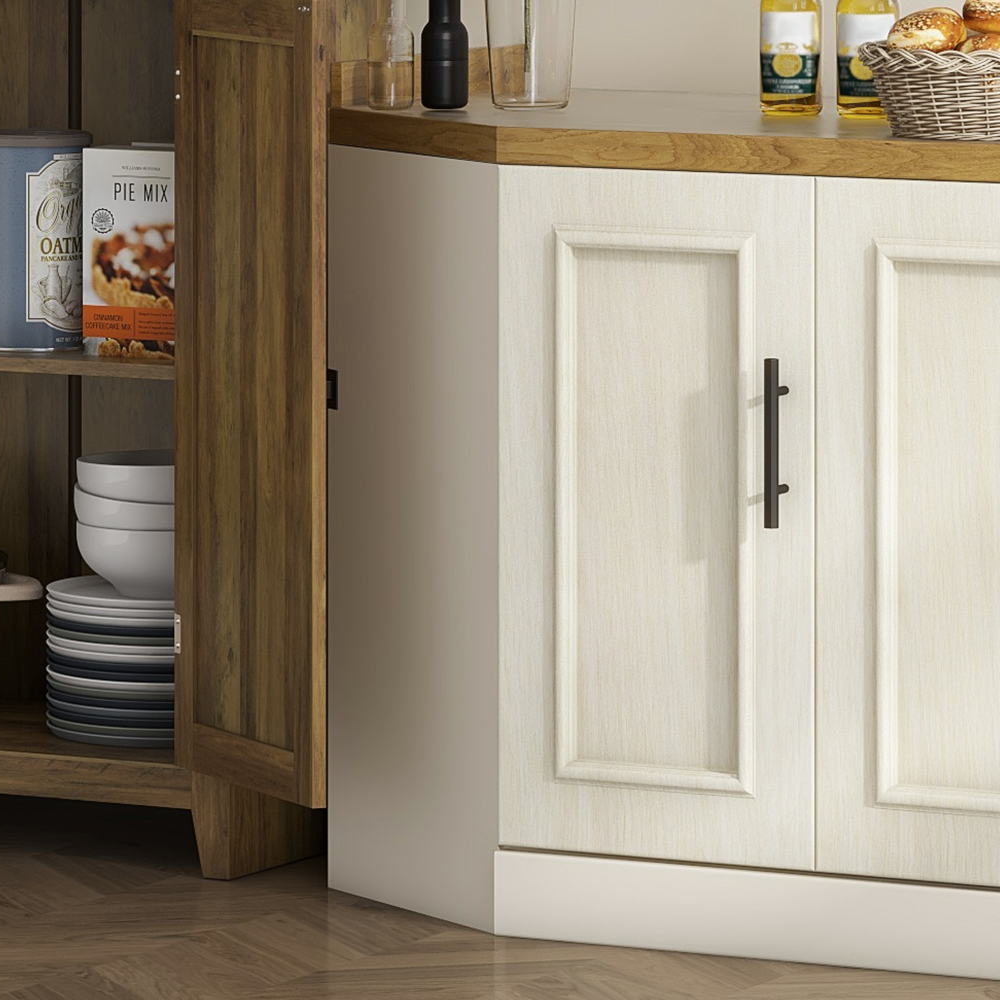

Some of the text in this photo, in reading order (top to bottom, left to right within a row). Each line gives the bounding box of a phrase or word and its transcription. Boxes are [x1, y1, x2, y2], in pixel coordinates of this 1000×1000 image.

[113, 182, 168, 202] PIE MIX
[93, 313, 123, 322] CINNAMON
[85, 321, 119, 331] COFFEECAKE
[121, 323, 132, 331] MIX
